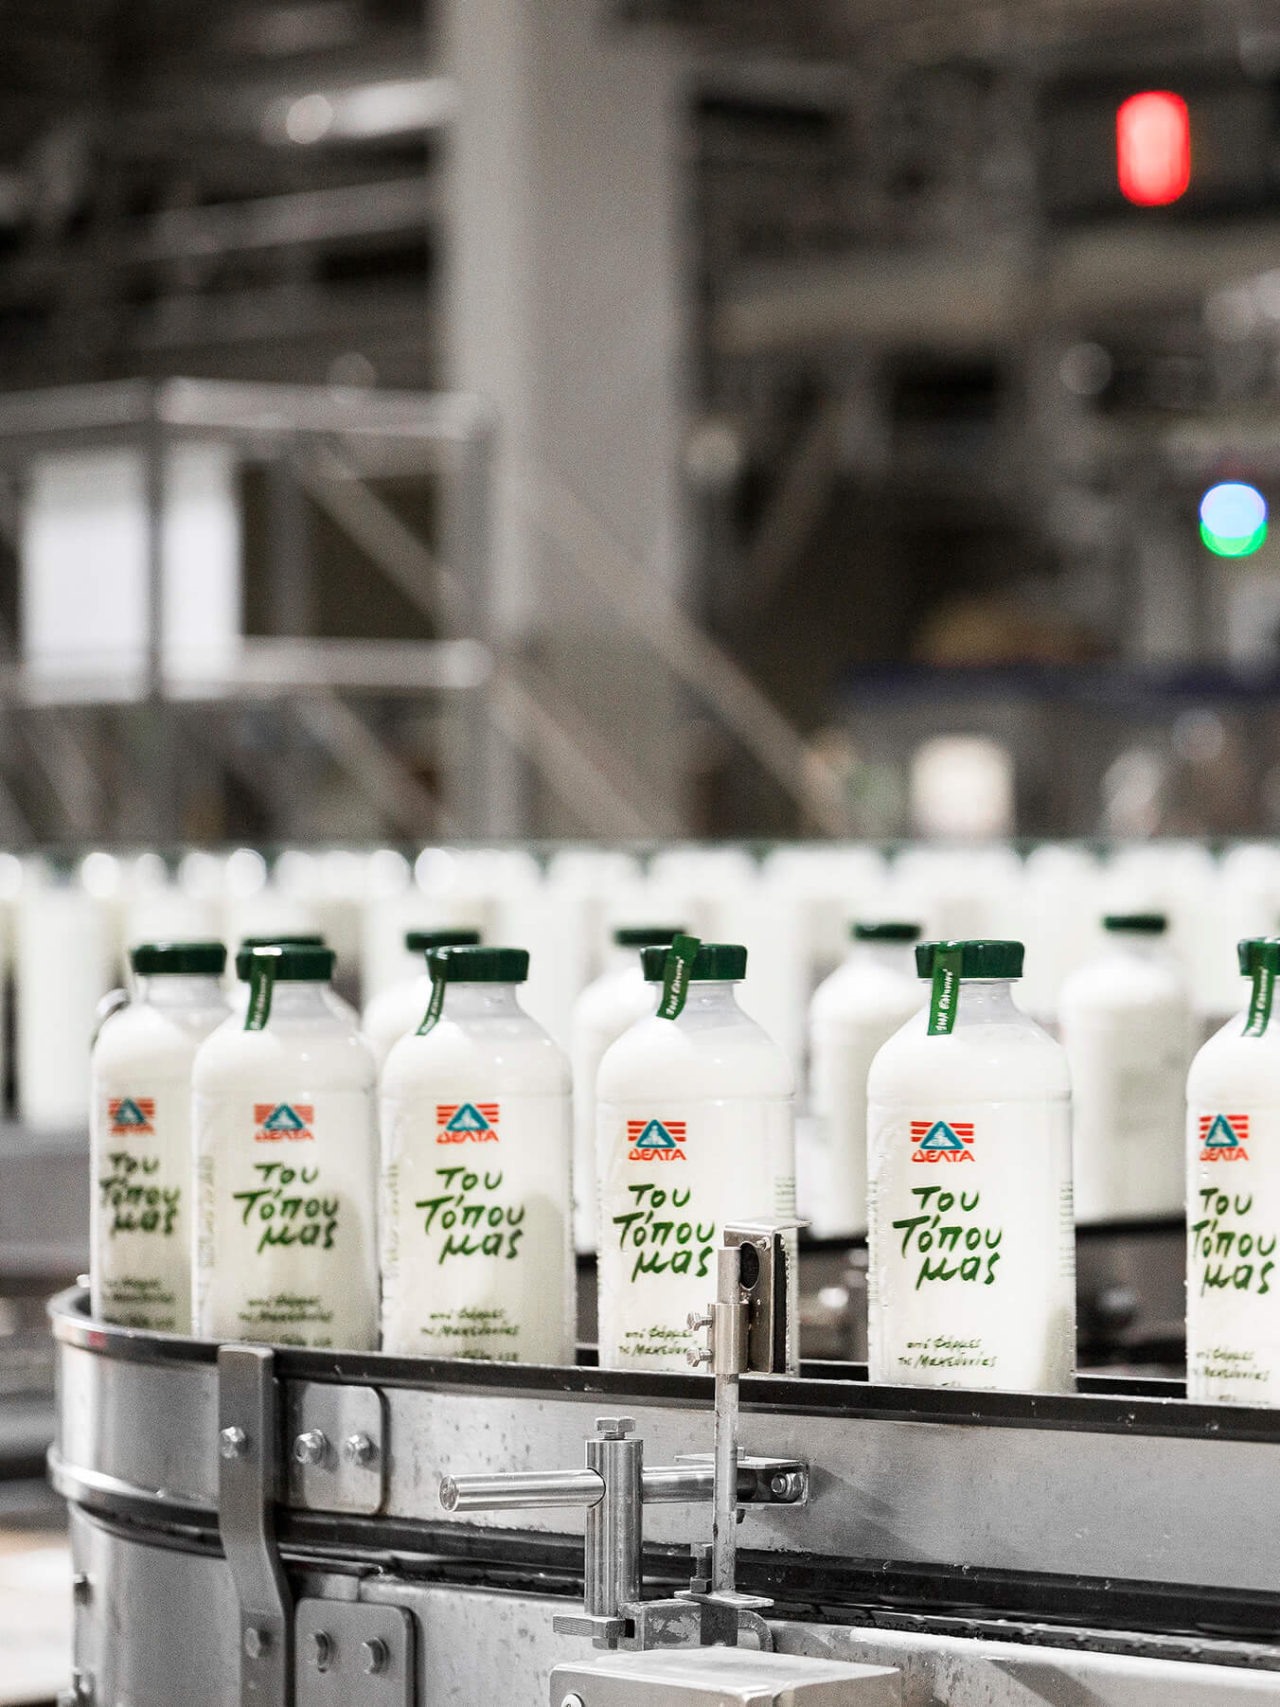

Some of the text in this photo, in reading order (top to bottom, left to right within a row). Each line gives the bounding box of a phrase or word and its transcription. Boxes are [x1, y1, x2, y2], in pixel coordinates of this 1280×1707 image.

[435, 1130, 499, 1145] ΔΕΛΤΑ
[627, 1148, 687, 1162] ΔΕΛΤΑ
[911, 1149, 975, 1164] ΔΕΛΤΑ
[1200, 1147, 1249, 1163] ΔΕΛΤΑ
[254, 1162, 318, 1184] Του
[435, 1166, 502, 1191] Του
[233, 1188, 340, 1226] Τόπου
[628, 1183, 691, 1208] Του
[911, 1186, 979, 1212] Του
[1199, 1187, 1252, 1216] Του
[415, 1194, 525, 1236] Τόπου
[612, 1210, 715, 1250] Τόπου
[257, 1219, 339, 1253] μας
[438, 1227, 524, 1265] μας
[892, 1214, 1002, 1260] Τόπου
[1190, 1219, 1276, 1262] Τόπου
[631, 1244, 714, 1283] μας
[915, 1250, 1000, 1291] μας
[1200, 1258, 1275, 1297] μας
